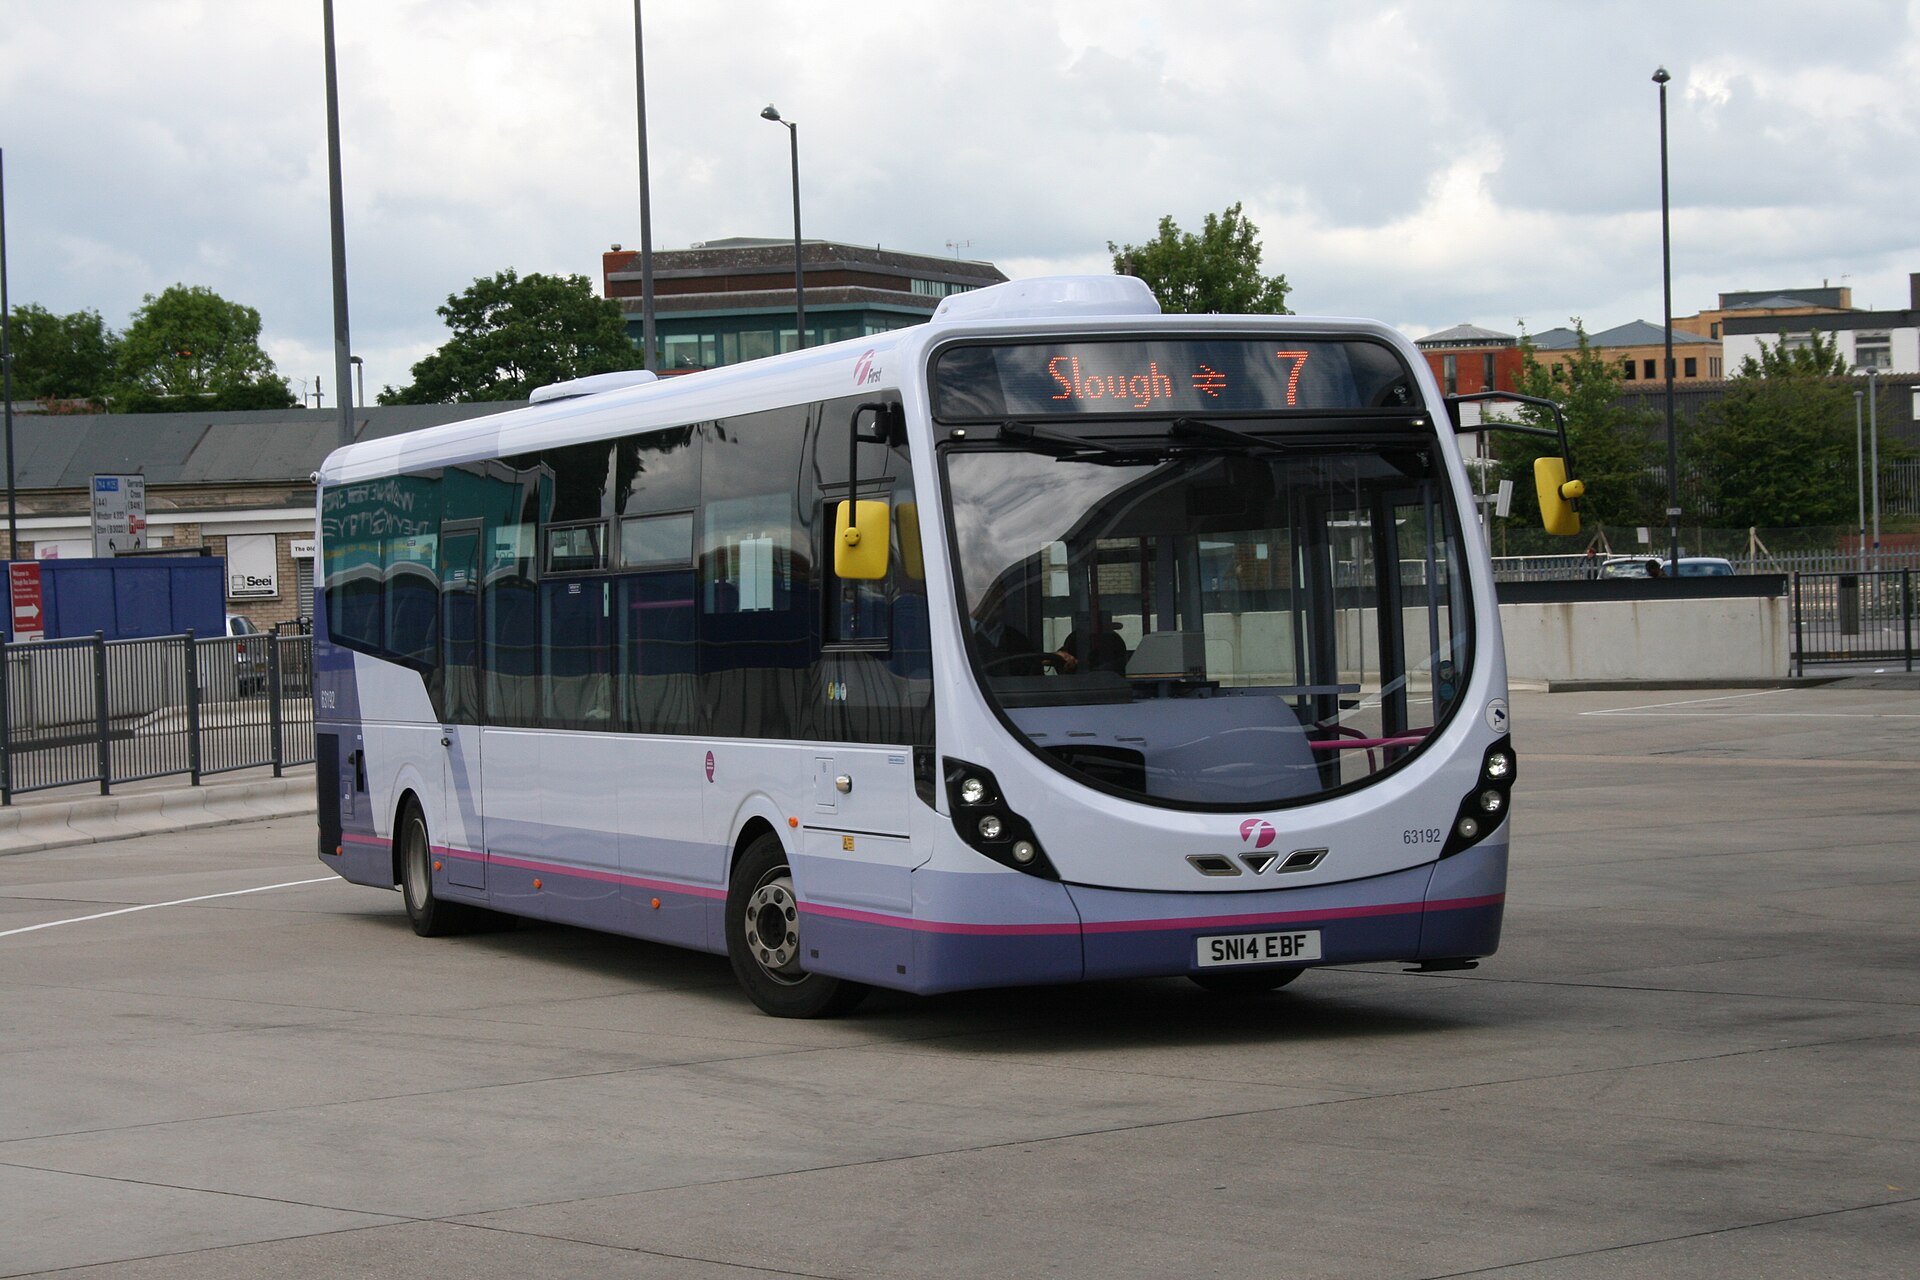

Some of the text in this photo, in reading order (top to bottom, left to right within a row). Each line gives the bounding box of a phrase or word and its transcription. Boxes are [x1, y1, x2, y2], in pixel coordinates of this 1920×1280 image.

[867, 368, 882, 384] First
[1048, 356, 1172, 408] Slough
[1277, 351, 1309, 406] 7
[246, 575, 272, 586] Seei
[1403, 828, 1441, 845] 63192
[1211, 934, 1307, 962] SN14 EBF
